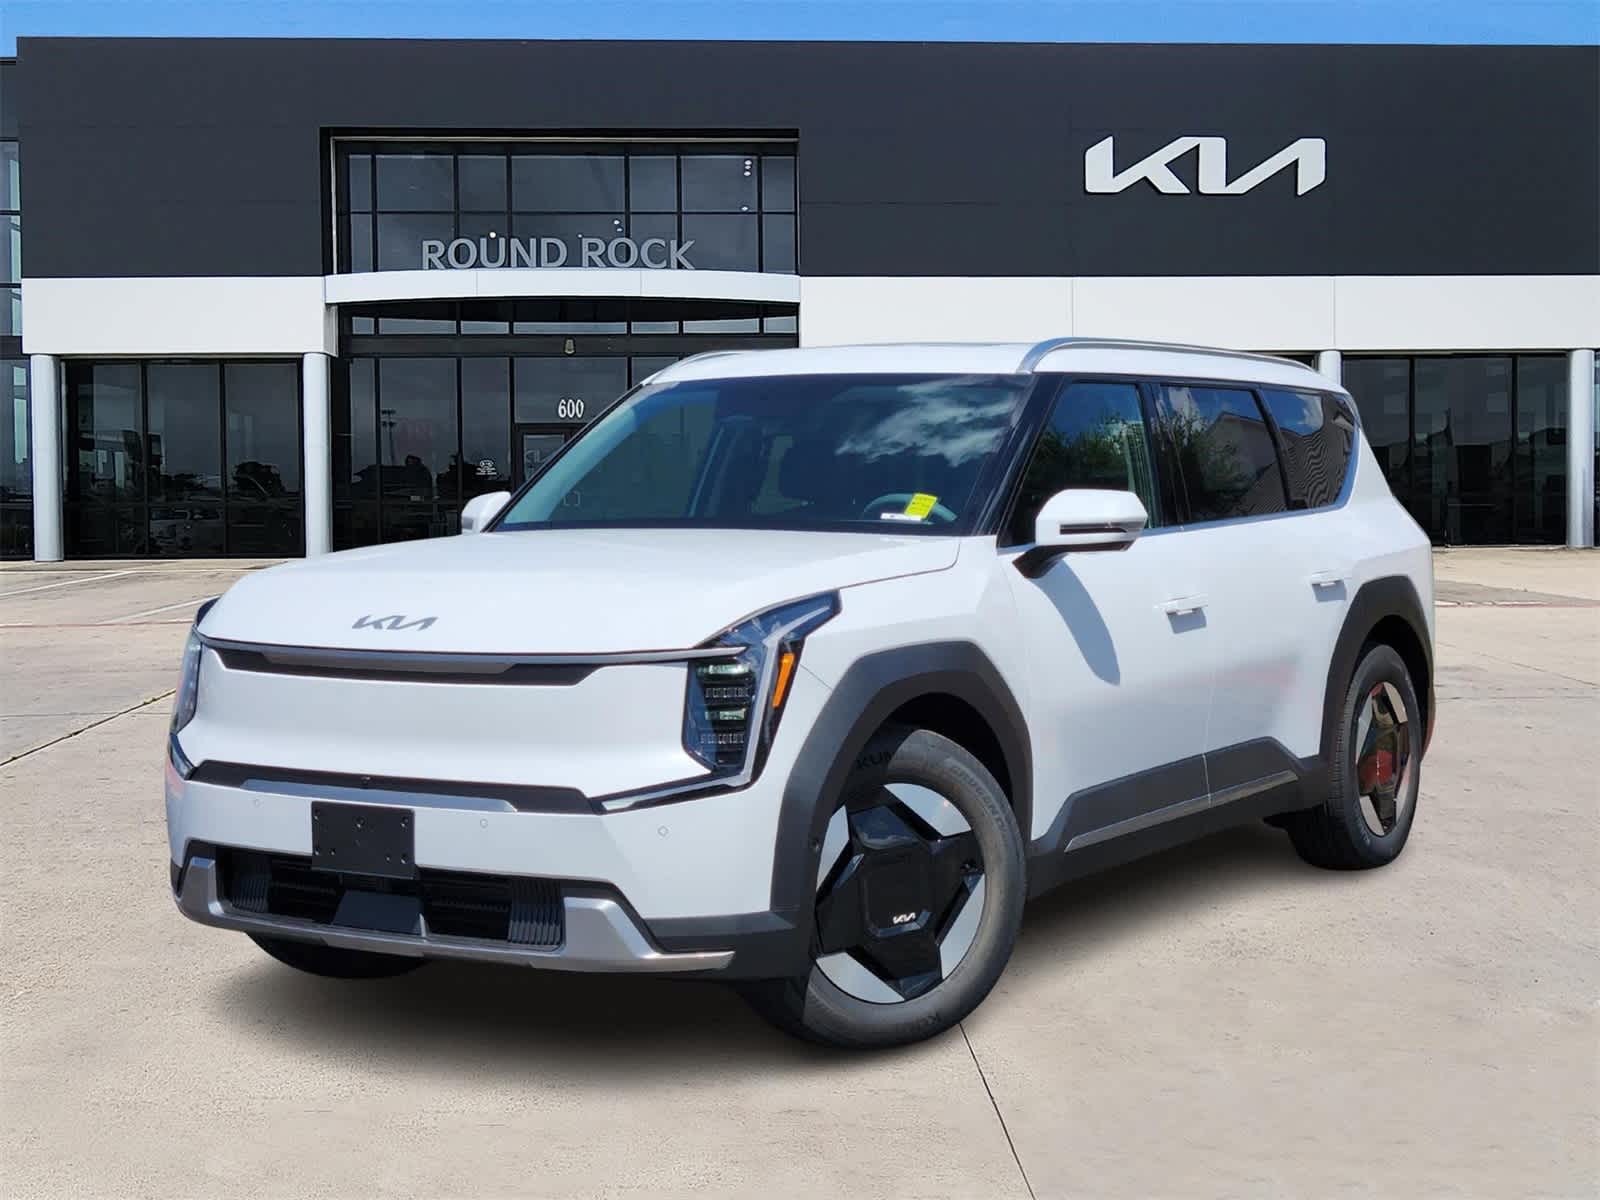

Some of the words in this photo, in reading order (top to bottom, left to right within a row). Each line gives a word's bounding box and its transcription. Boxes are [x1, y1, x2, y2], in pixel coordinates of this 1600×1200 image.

[1085, 136, 1326, 196] KIA
[422, 238, 568, 270] ROUND
[582, 237, 696, 270] ROCK
[558, 399, 585, 418] 600
[351, 615, 438, 631] KIA
